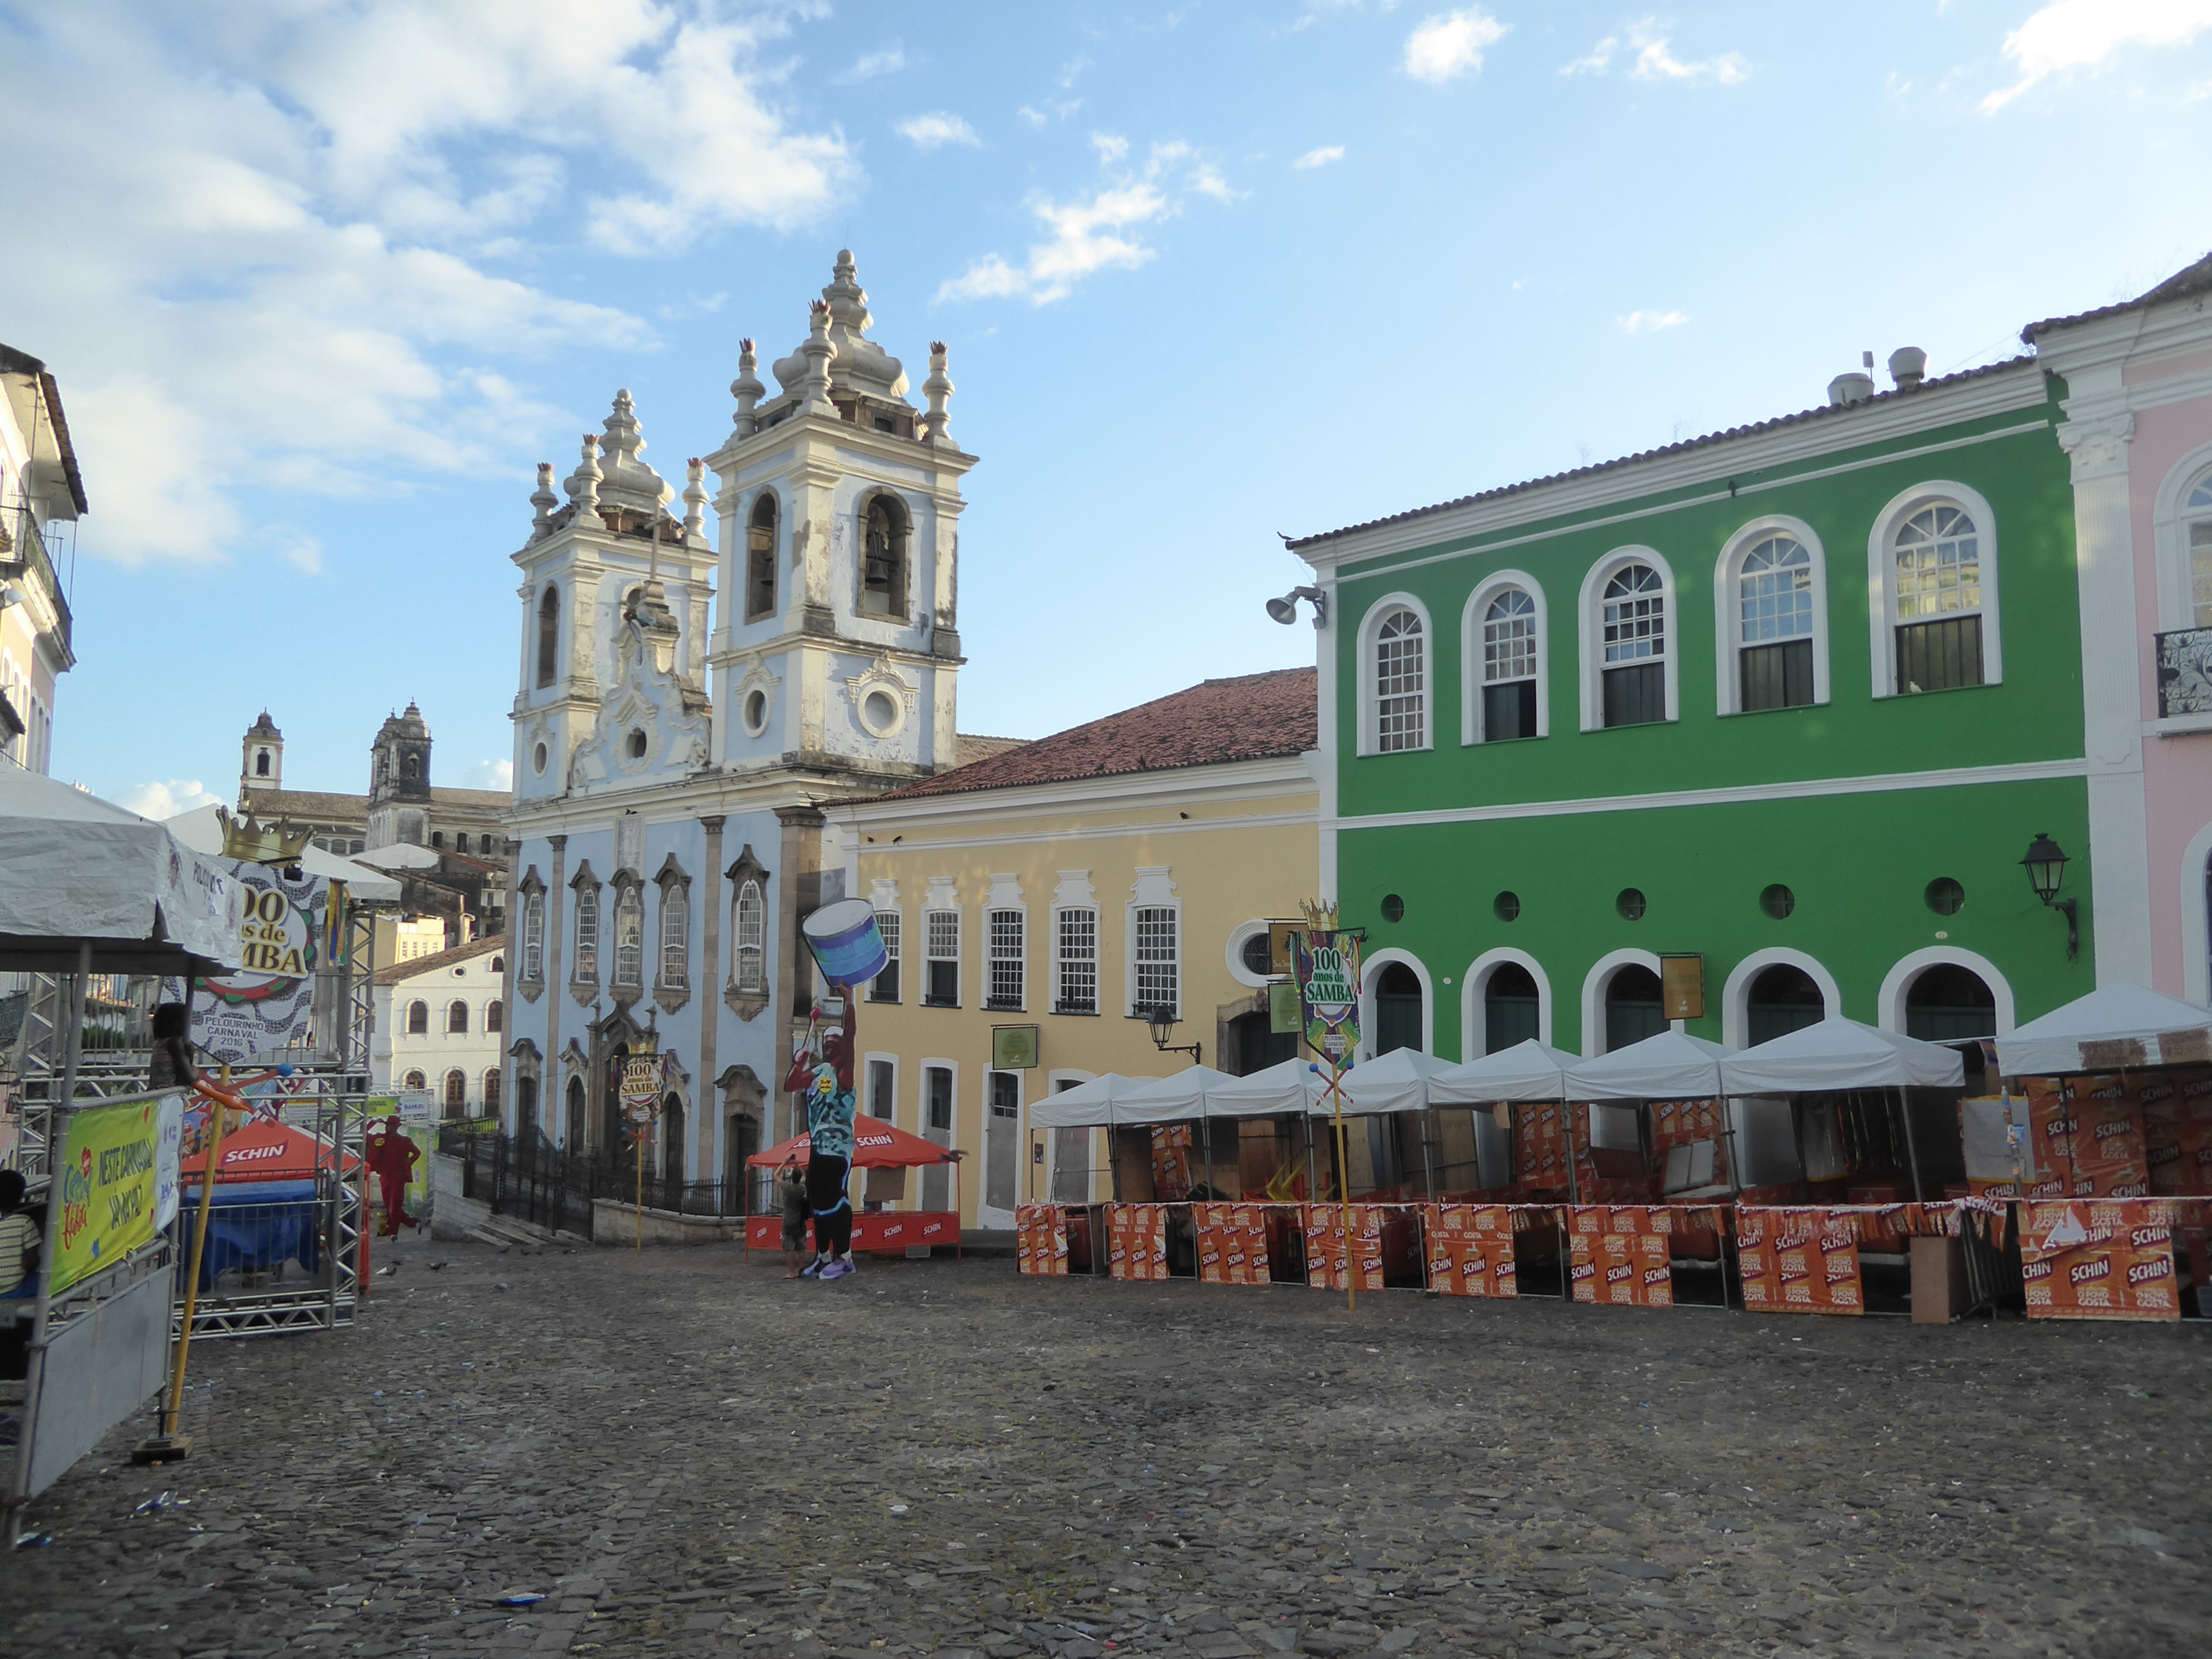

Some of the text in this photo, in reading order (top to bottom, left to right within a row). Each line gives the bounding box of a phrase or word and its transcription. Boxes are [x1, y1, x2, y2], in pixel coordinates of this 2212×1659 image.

[260, 925, 285, 940] de
[1312, 949, 1340, 971] 100
[1314, 971, 1344, 982] anos de
[1306, 984, 1354, 1002] SAMBA
[205, 1016, 264, 1031] PELOURINHO
[207, 1026, 258, 1039] CARNAVAL
[221, 1037, 243, 1047] 2016
[629, 1064, 651, 1076] 100
[621, 1083, 660, 1094] SAMBA
[2096, 1119, 2130, 1138] SCHIN
[857, 1135, 893, 1146] SCHIN
[225, 1145, 284, 1162] SCHIN
[2073, 1181, 2093, 1196] HIN
[851, 1228, 862, 1239] HIN
[884, 1224, 902, 1238] SCHIN
[924, 1222, 941, 1235] SCHIN
[1307, 1227, 1326, 1238] SCHIN
[2132, 1228, 2170, 1245] SCHIN
[1112, 1248, 1125, 1261] SCHIN
[1133, 1249, 1146, 1262] SCHIN
[1203, 1251, 1219, 1264] SCHIN
[1228, 1252, 1244, 1265] SCHIN
[1308, 1255, 1325, 1270] SCHIN
[1363, 1256, 1382, 1271] SCHIN
[1430, 1258, 1452, 1273] SCHIN
[1463, 1259, 1485, 1274] SCHIN
[2022, 1260, 2051, 1279] CHIN
[1572, 1263, 1594, 1279] SCHIN
[1608, 1264, 1632, 1281] SCHIN
[1645, 1266, 1670, 1283] SCHIN
[2071, 1260, 2109, 1281] SCHIN
[2129, 1260, 2168, 1282] SCHIN
